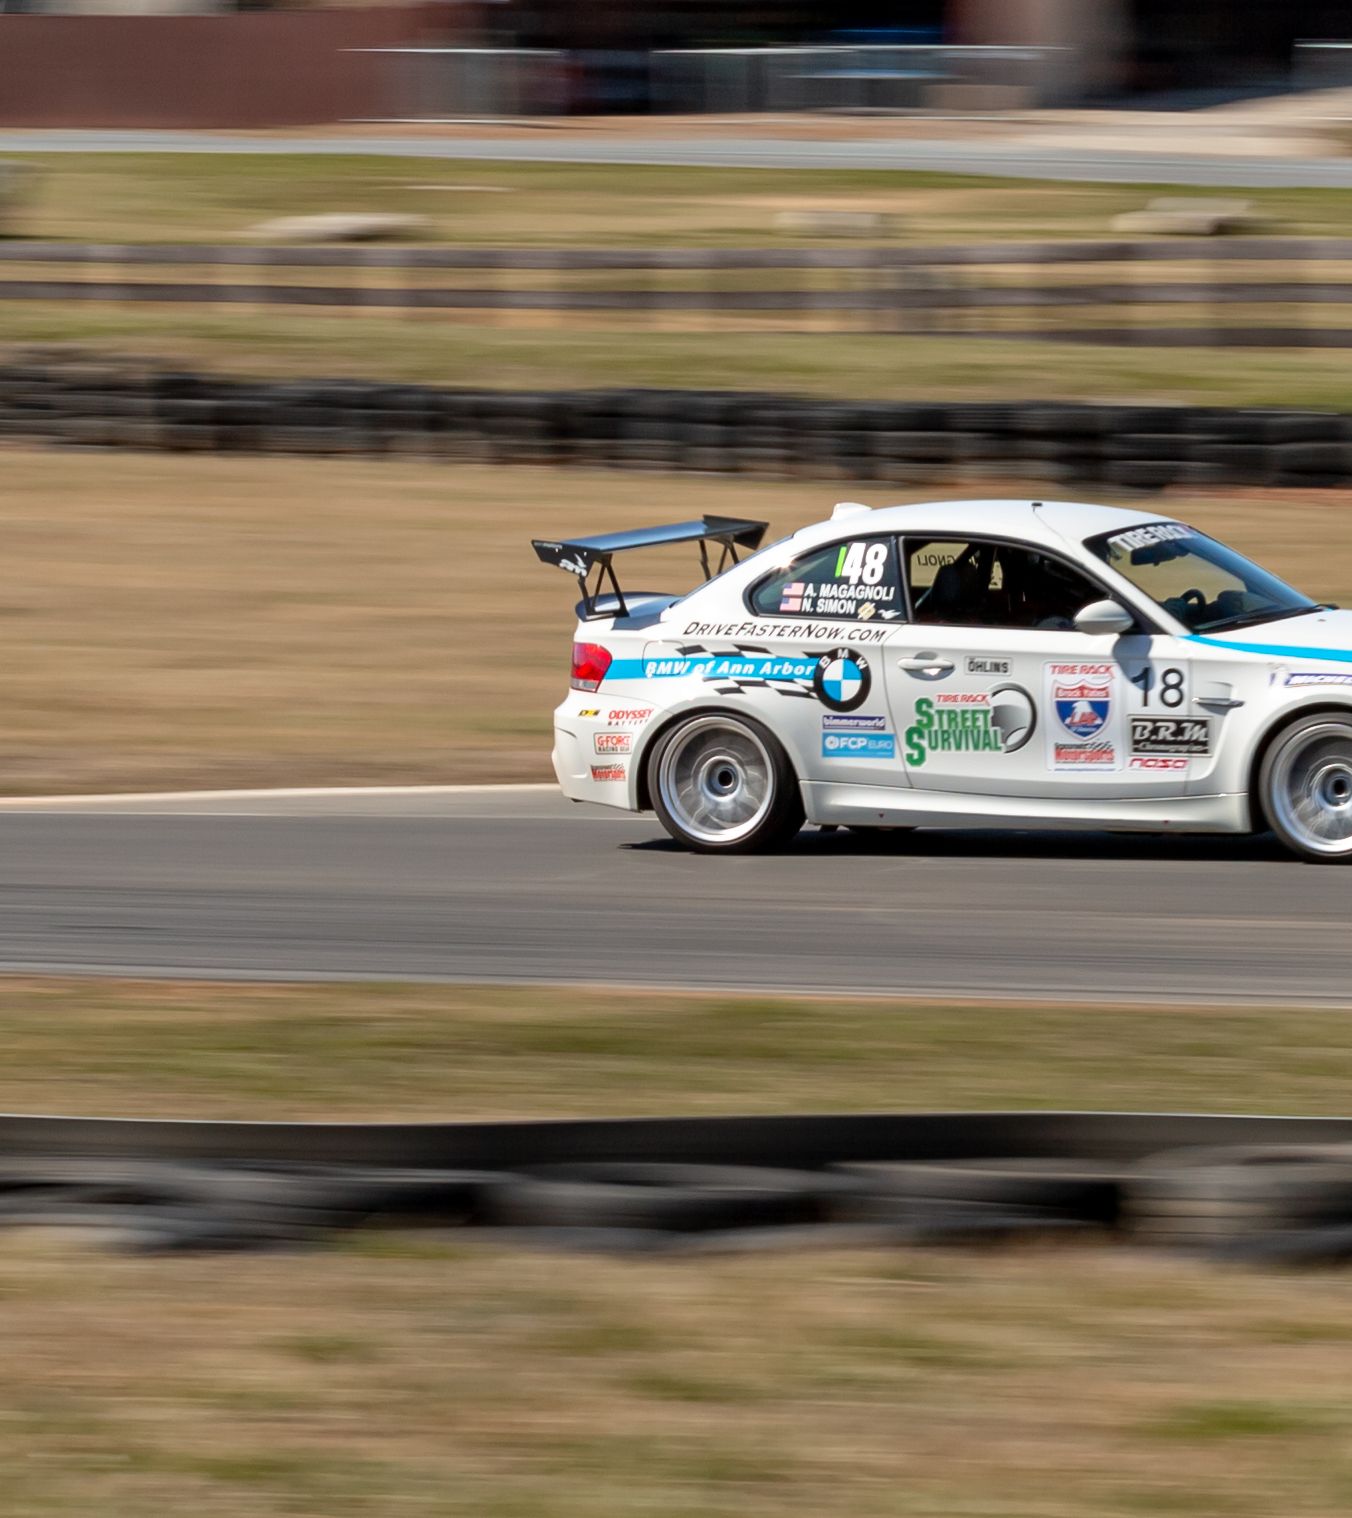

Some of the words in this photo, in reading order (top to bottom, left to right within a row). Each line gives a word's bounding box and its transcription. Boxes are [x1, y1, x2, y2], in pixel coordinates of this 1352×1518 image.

[842, 542, 889, 585] 48
[804, 583, 817, 597] A.
[819, 583, 895, 601] MAGAGNOLI
[801, 599, 814, 612] N.
[816, 599, 857, 614] SIMON
[645, 660, 691, 677] BMW
[692, 659, 716, 674] of
[716, 661, 753, 675] Ann
[759, 661, 816, 676] Arbor
[967, 658, 1009, 674] ÖHLINS
[1051, 664, 1078, 675] TIRE
[1079, 664, 1115, 679] RACK
[1131, 667, 1184, 708] 18
[609, 709, 654, 720] ODYSSEY
[915, 698, 991, 730] STREET
[839, 736, 868, 749] FCP
[905, 726, 1002, 767] SURVIVAL
